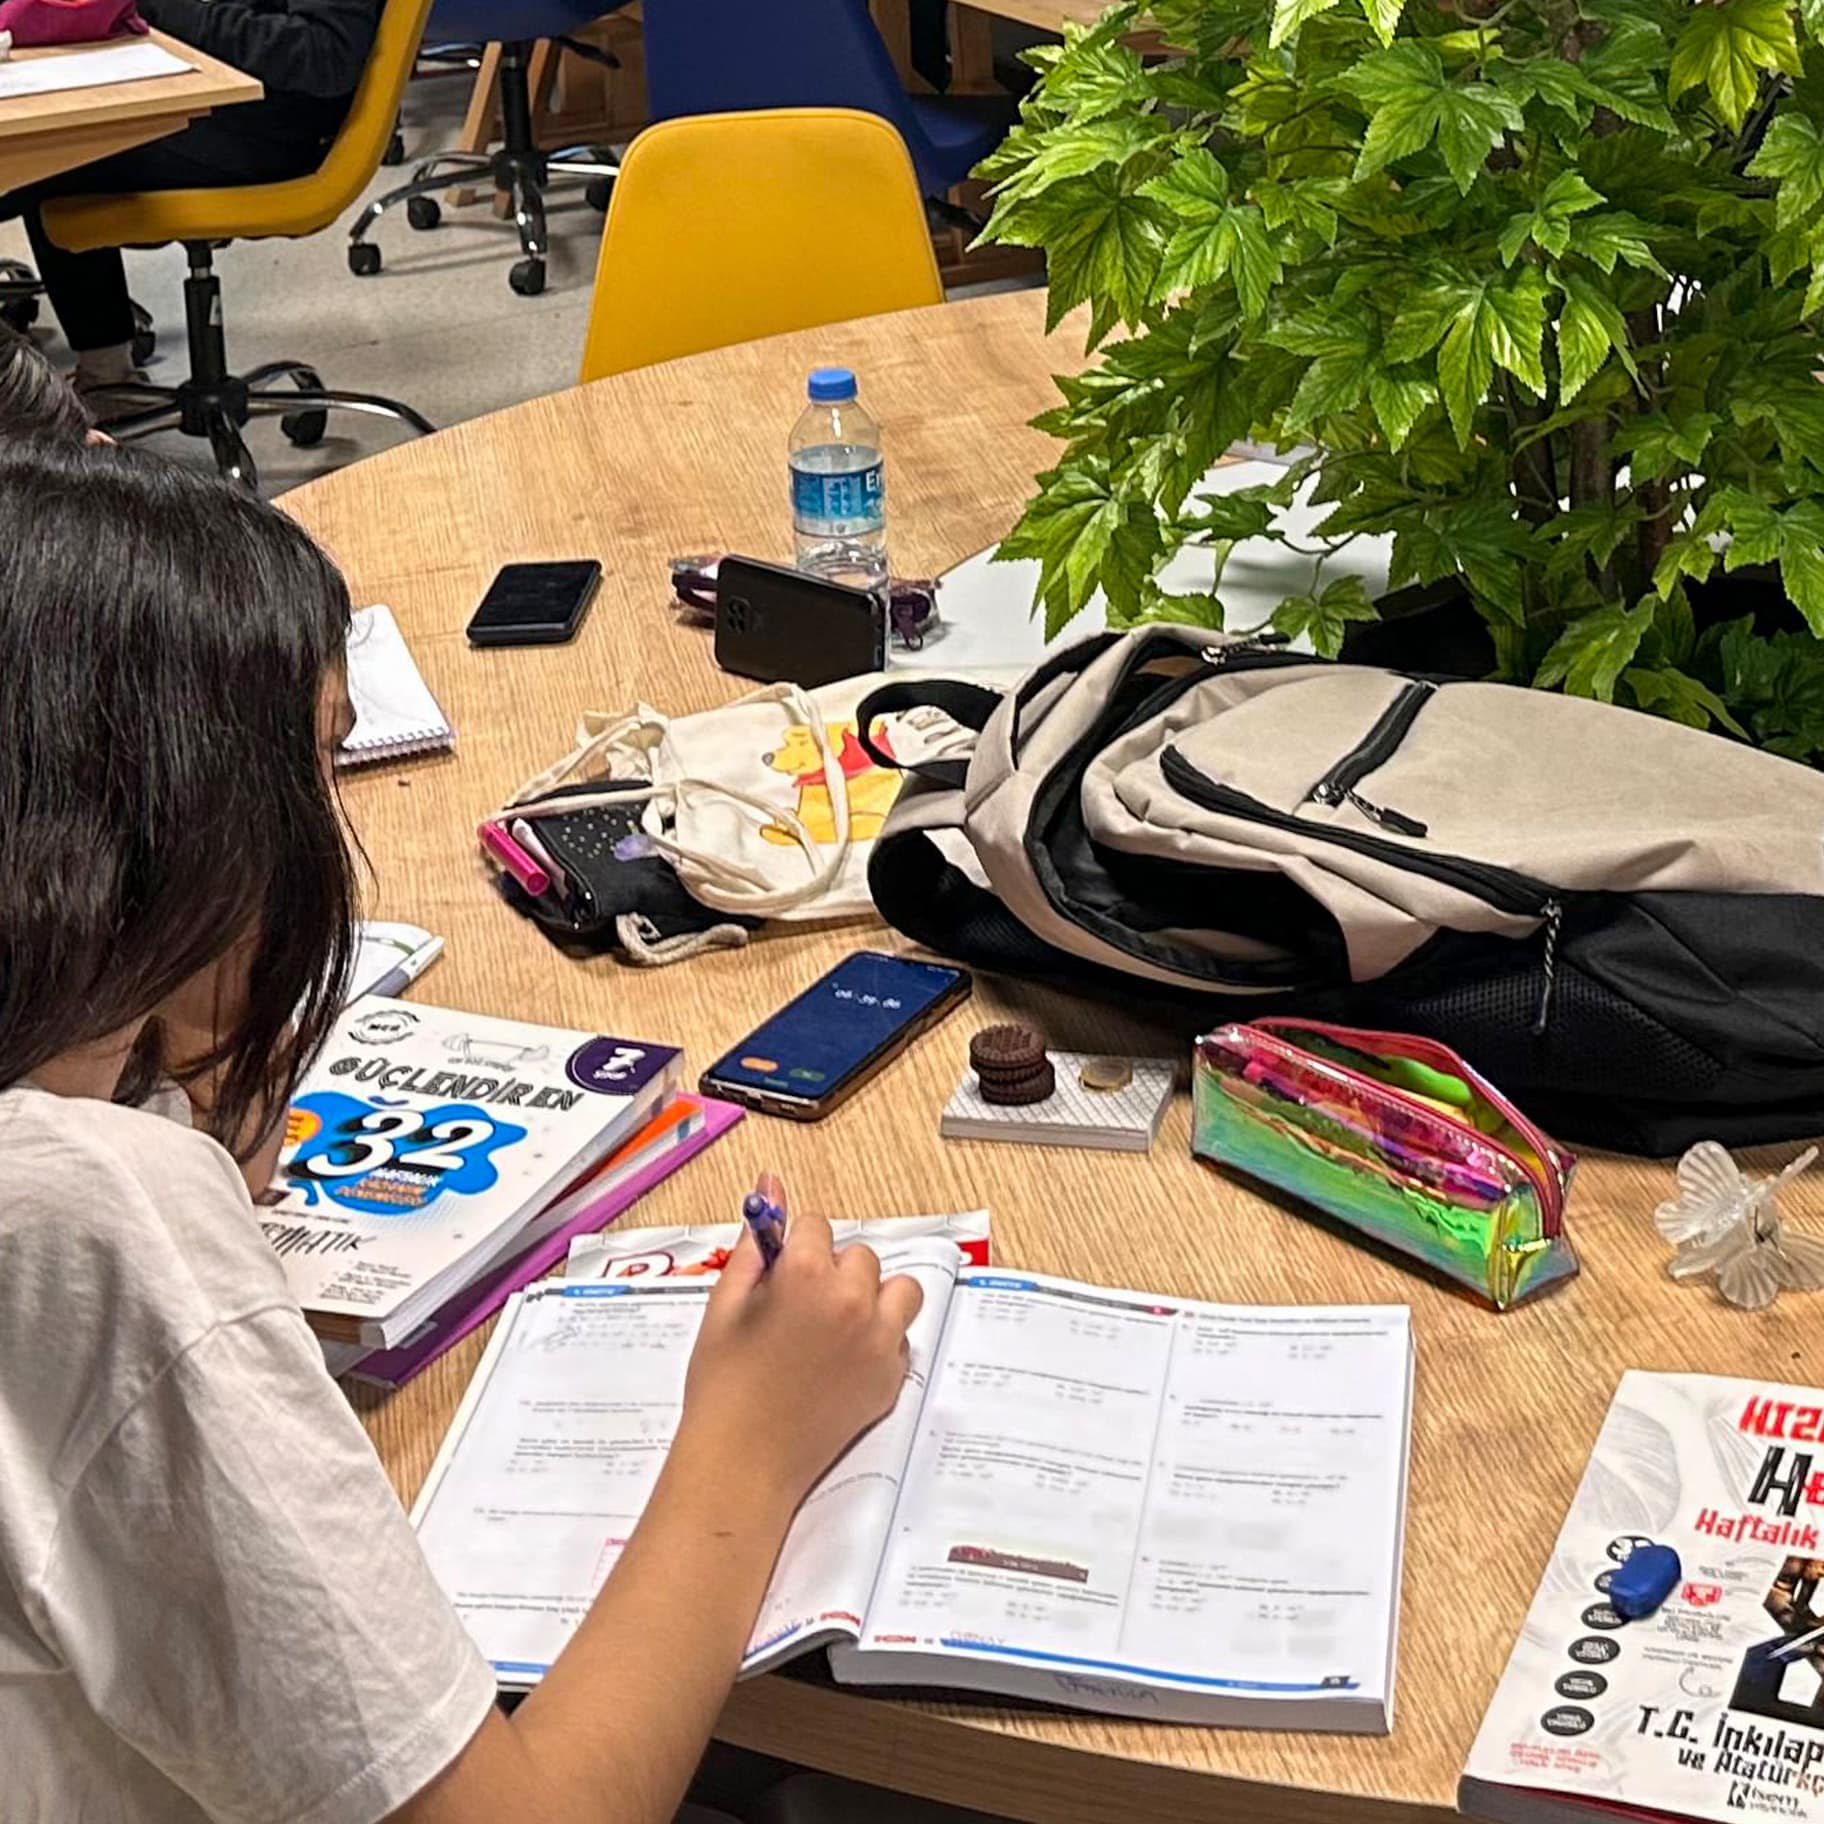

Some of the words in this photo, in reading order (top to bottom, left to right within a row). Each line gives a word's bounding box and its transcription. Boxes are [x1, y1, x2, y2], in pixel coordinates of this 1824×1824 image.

[306, 1109, 496, 1177] 32
[1694, 1508, 1820, 1550] Haftalık
[1678, 1748, 1706, 1771] ve
